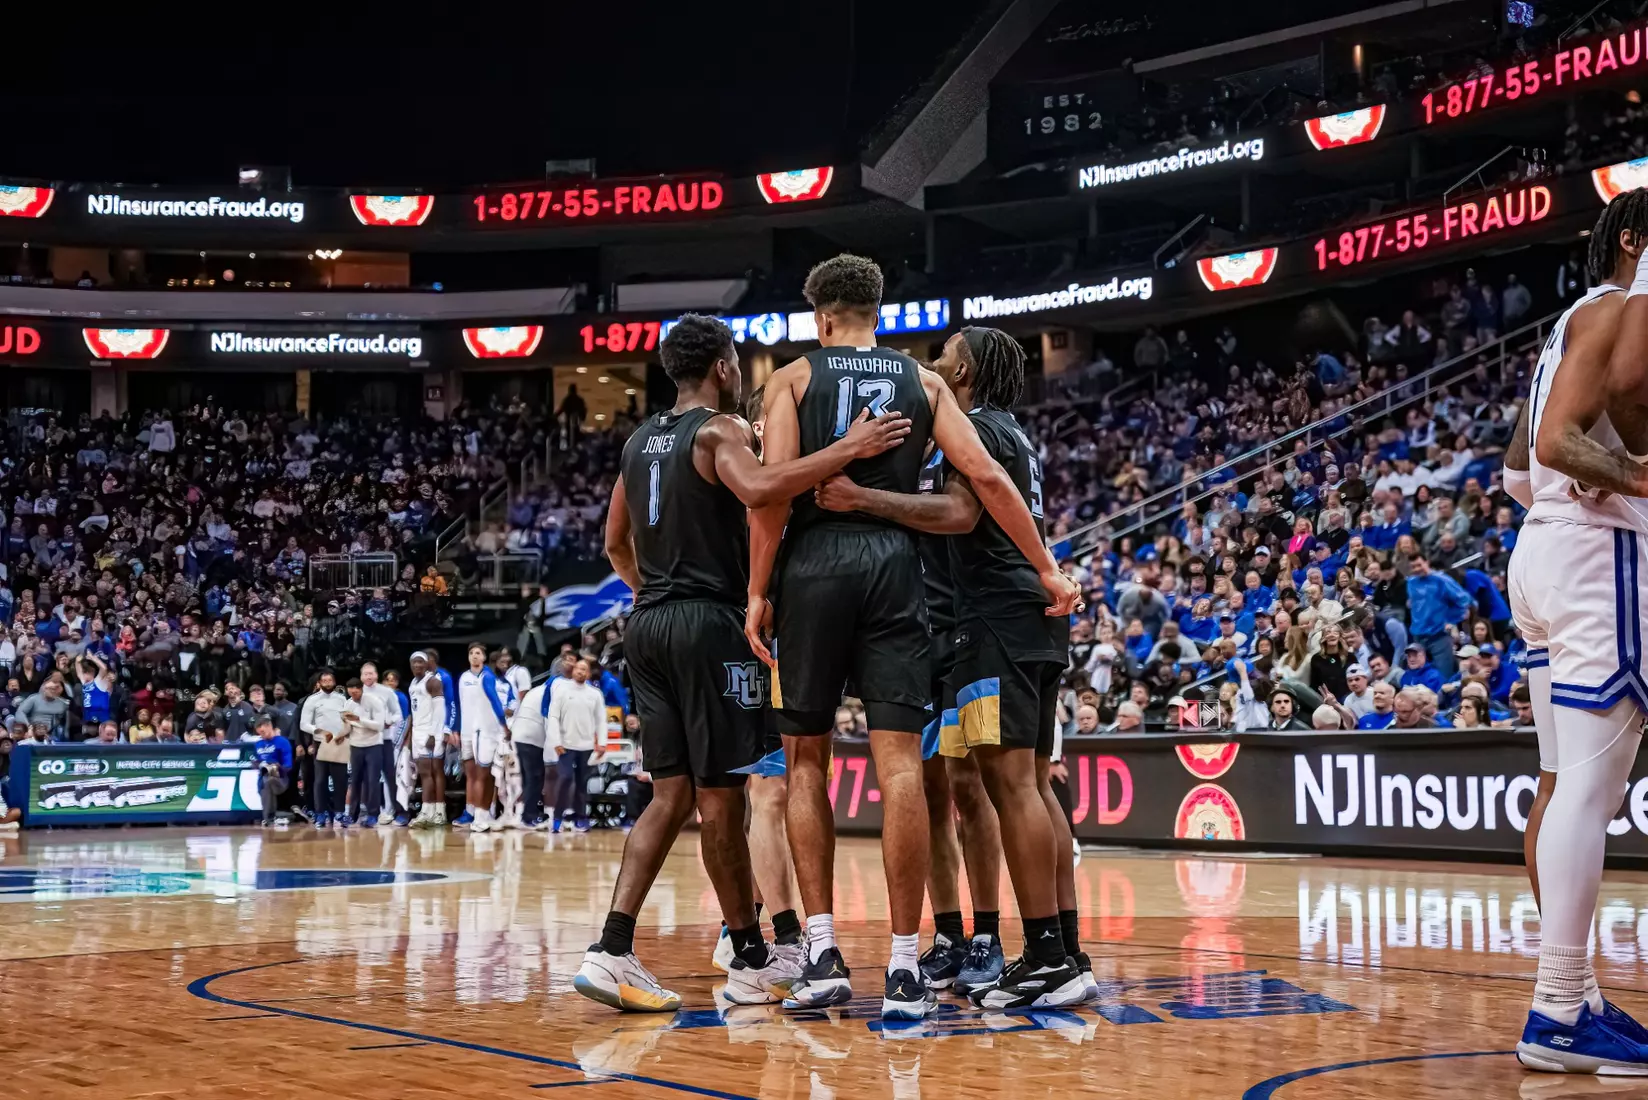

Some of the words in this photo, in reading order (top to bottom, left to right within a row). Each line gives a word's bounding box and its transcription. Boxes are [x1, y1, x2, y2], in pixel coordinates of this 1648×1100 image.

[1421, 27, 1648, 124] 1-877-55-FRAU
[1024, 112, 1103, 135] 1982
[1079, 137, 1264, 190] NJInsuranceFraud.org
[87, 193, 305, 224] NJInsuranceFraud.org
[473, 181, 724, 222] 1-877-55-FRAUD
[1315, 185, 1552, 270] 1-877-55-FRAUD
[962, 276, 1154, 320] NJInsuranceFraud.org
[210, 332, 423, 358] NJInsuranceFraud.org
[580, 322, 661, 353] 1-877
[827, 356, 903, 374] IGHODARO
[642, 434, 676, 454] JONES
[648, 460, 660, 526] 1
[723, 661, 765, 710] MU
[1294, 753, 1648, 837] NJInsura
